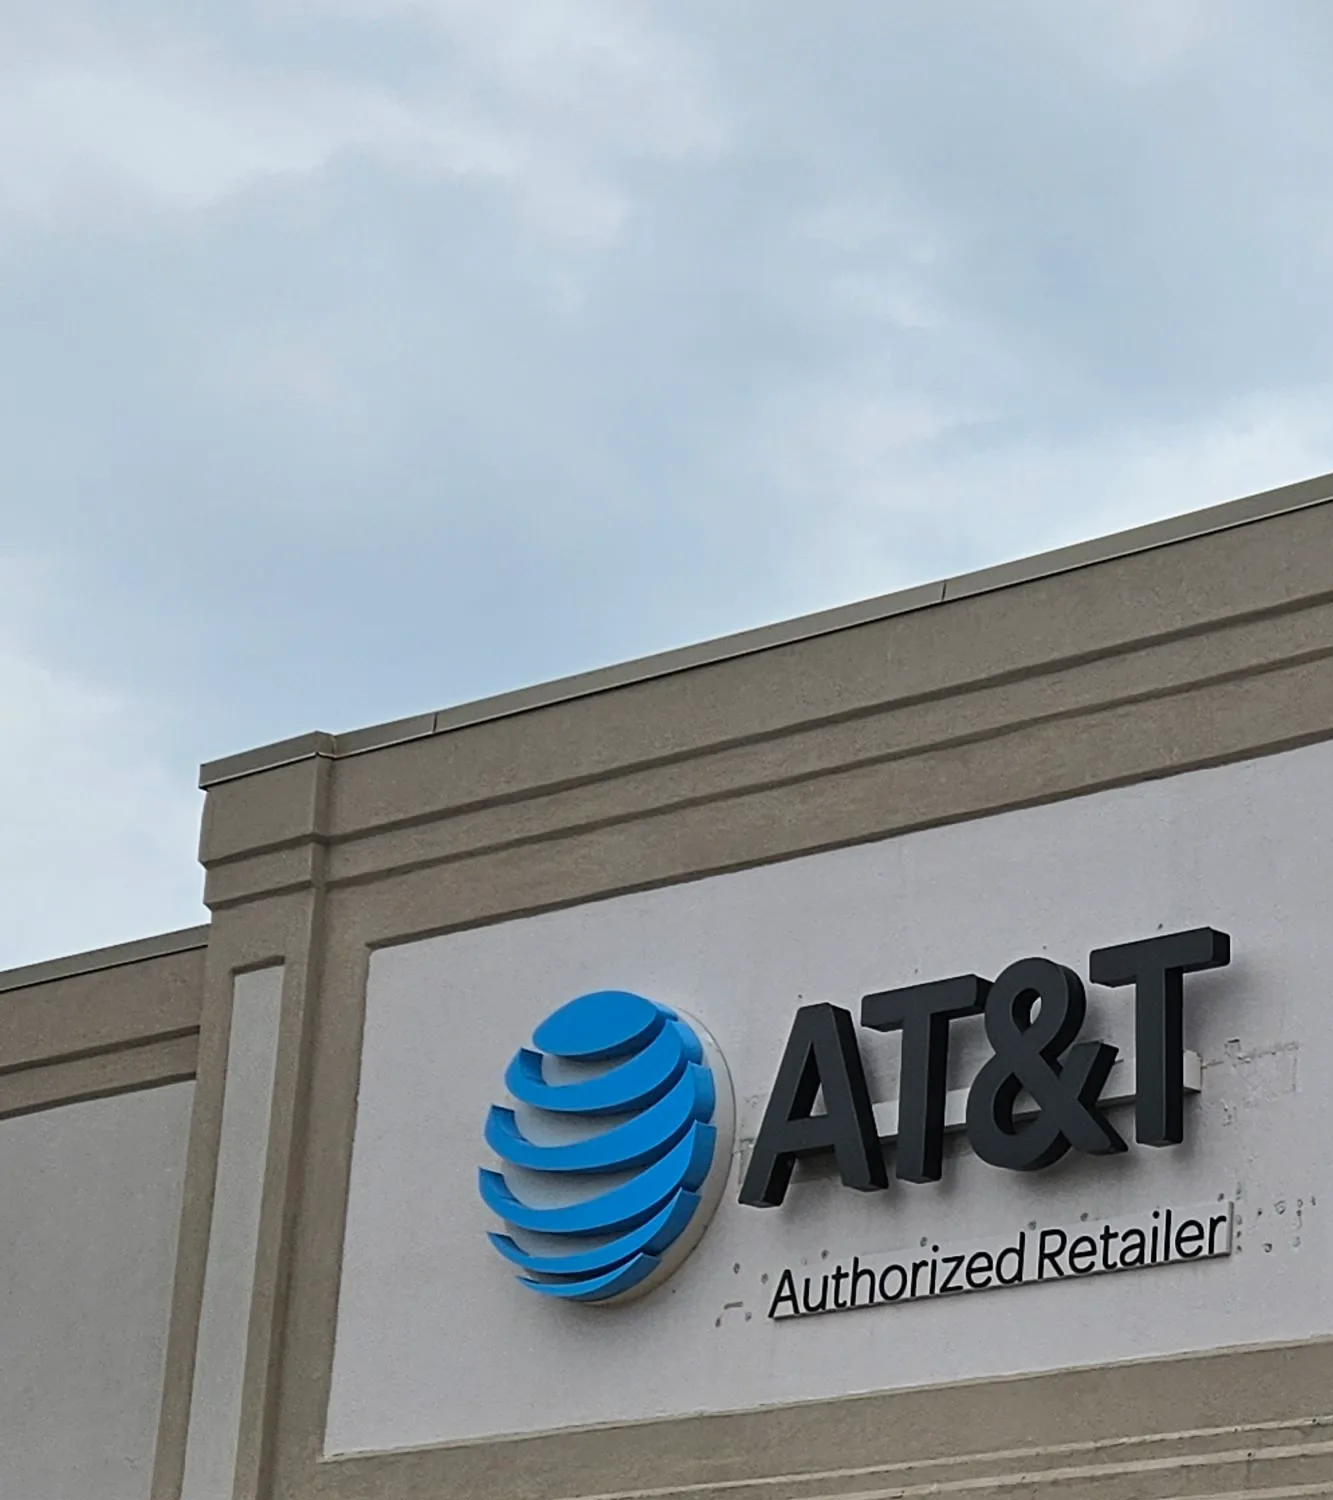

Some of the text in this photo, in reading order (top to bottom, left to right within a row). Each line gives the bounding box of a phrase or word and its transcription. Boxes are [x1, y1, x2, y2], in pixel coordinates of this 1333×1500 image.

[738, 926, 1231, 1208] AT&T
[768, 1209, 1228, 1318] Authorized Retailer
